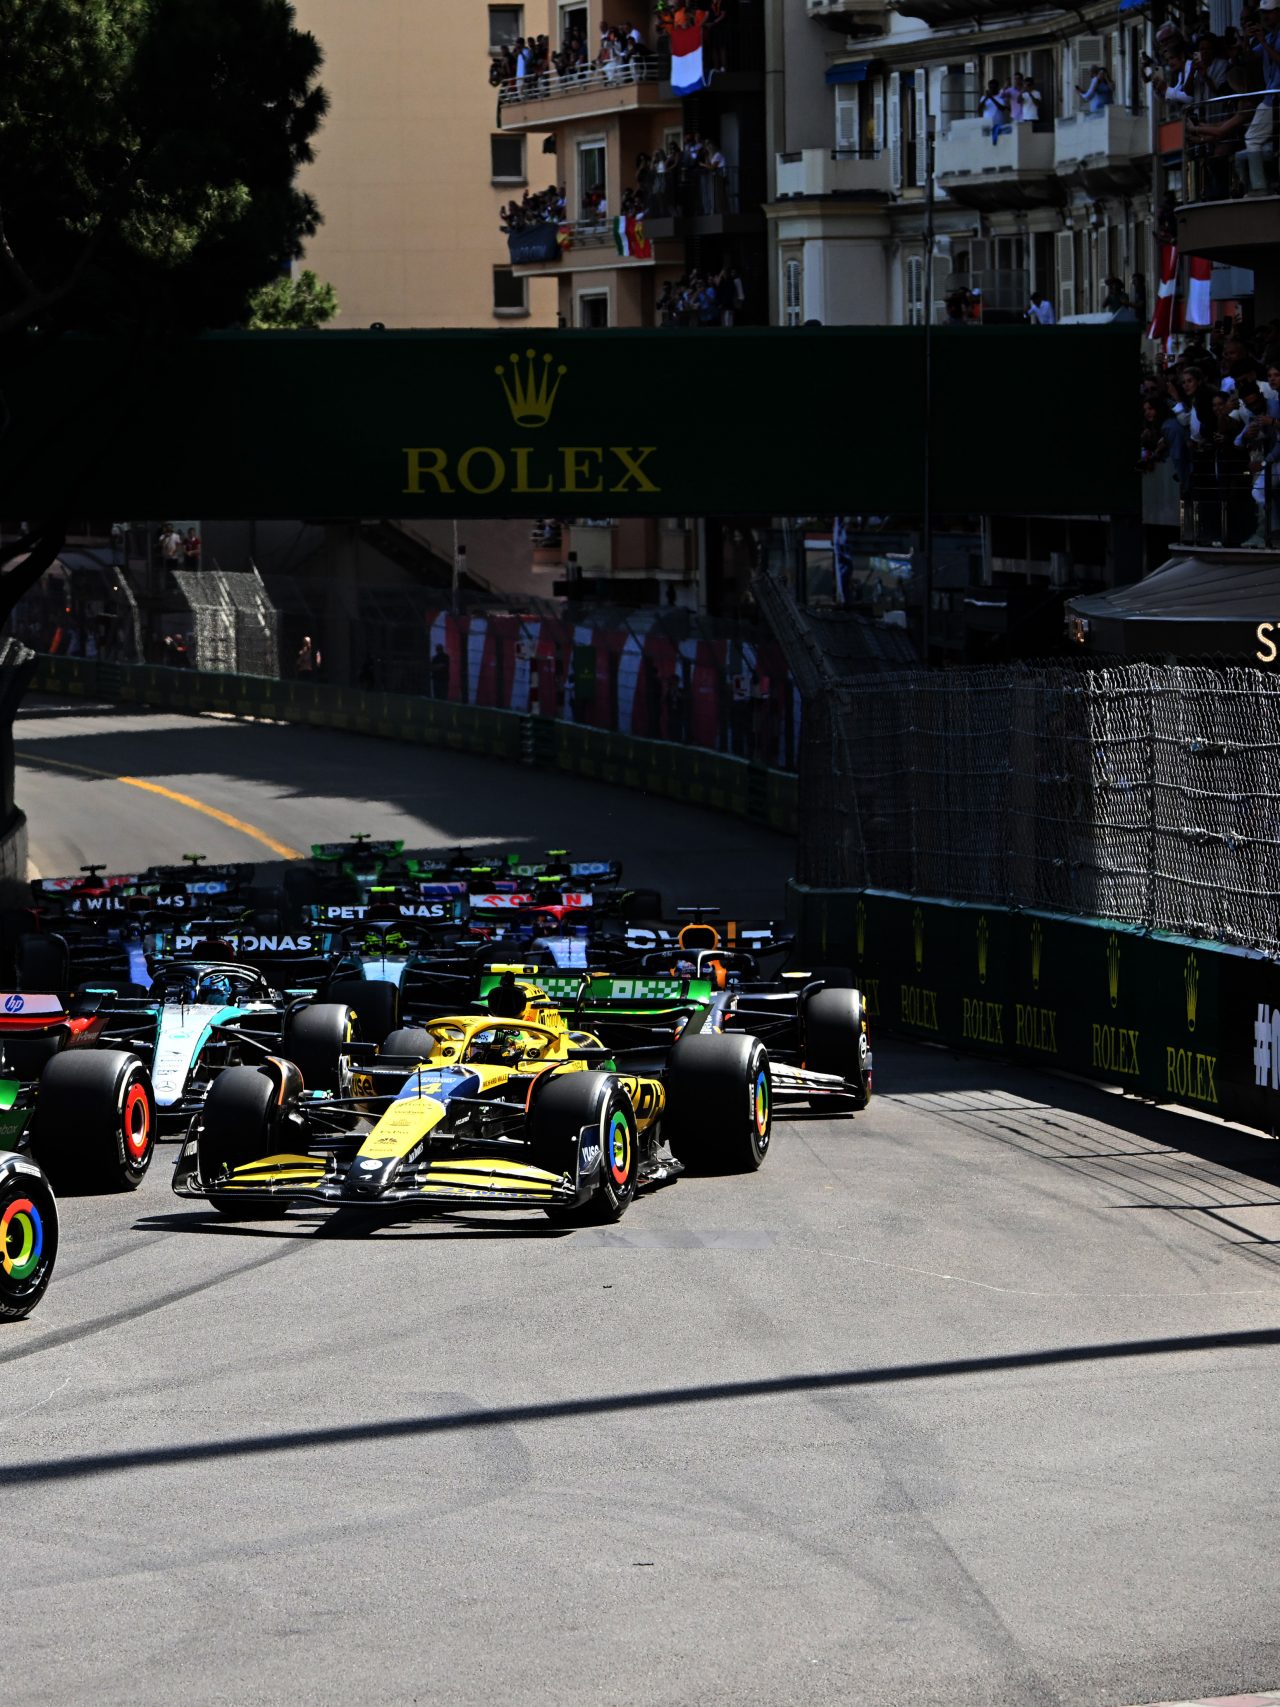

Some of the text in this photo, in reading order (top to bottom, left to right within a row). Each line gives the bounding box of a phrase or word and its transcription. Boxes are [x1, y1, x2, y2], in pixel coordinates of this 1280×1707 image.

[401, 446, 661, 494] ROLEX
[1256, 622, 1280, 662] S
[87, 896, 185, 910] WILMS
[328, 904, 445, 919] PETNAS
[175, 935, 312, 951] PERONAS
[8, 997, 22, 1012] hp
[899, 984, 939, 1031] ROLEX
[962, 997, 1005, 1045] ROLEX
[1015, 1003, 1059, 1054] ROLEX
[1091, 1023, 1141, 1076] ROLEX
[411, 1083, 442, 1094] 4
[1164, 1046, 1219, 1104] ROLEX
